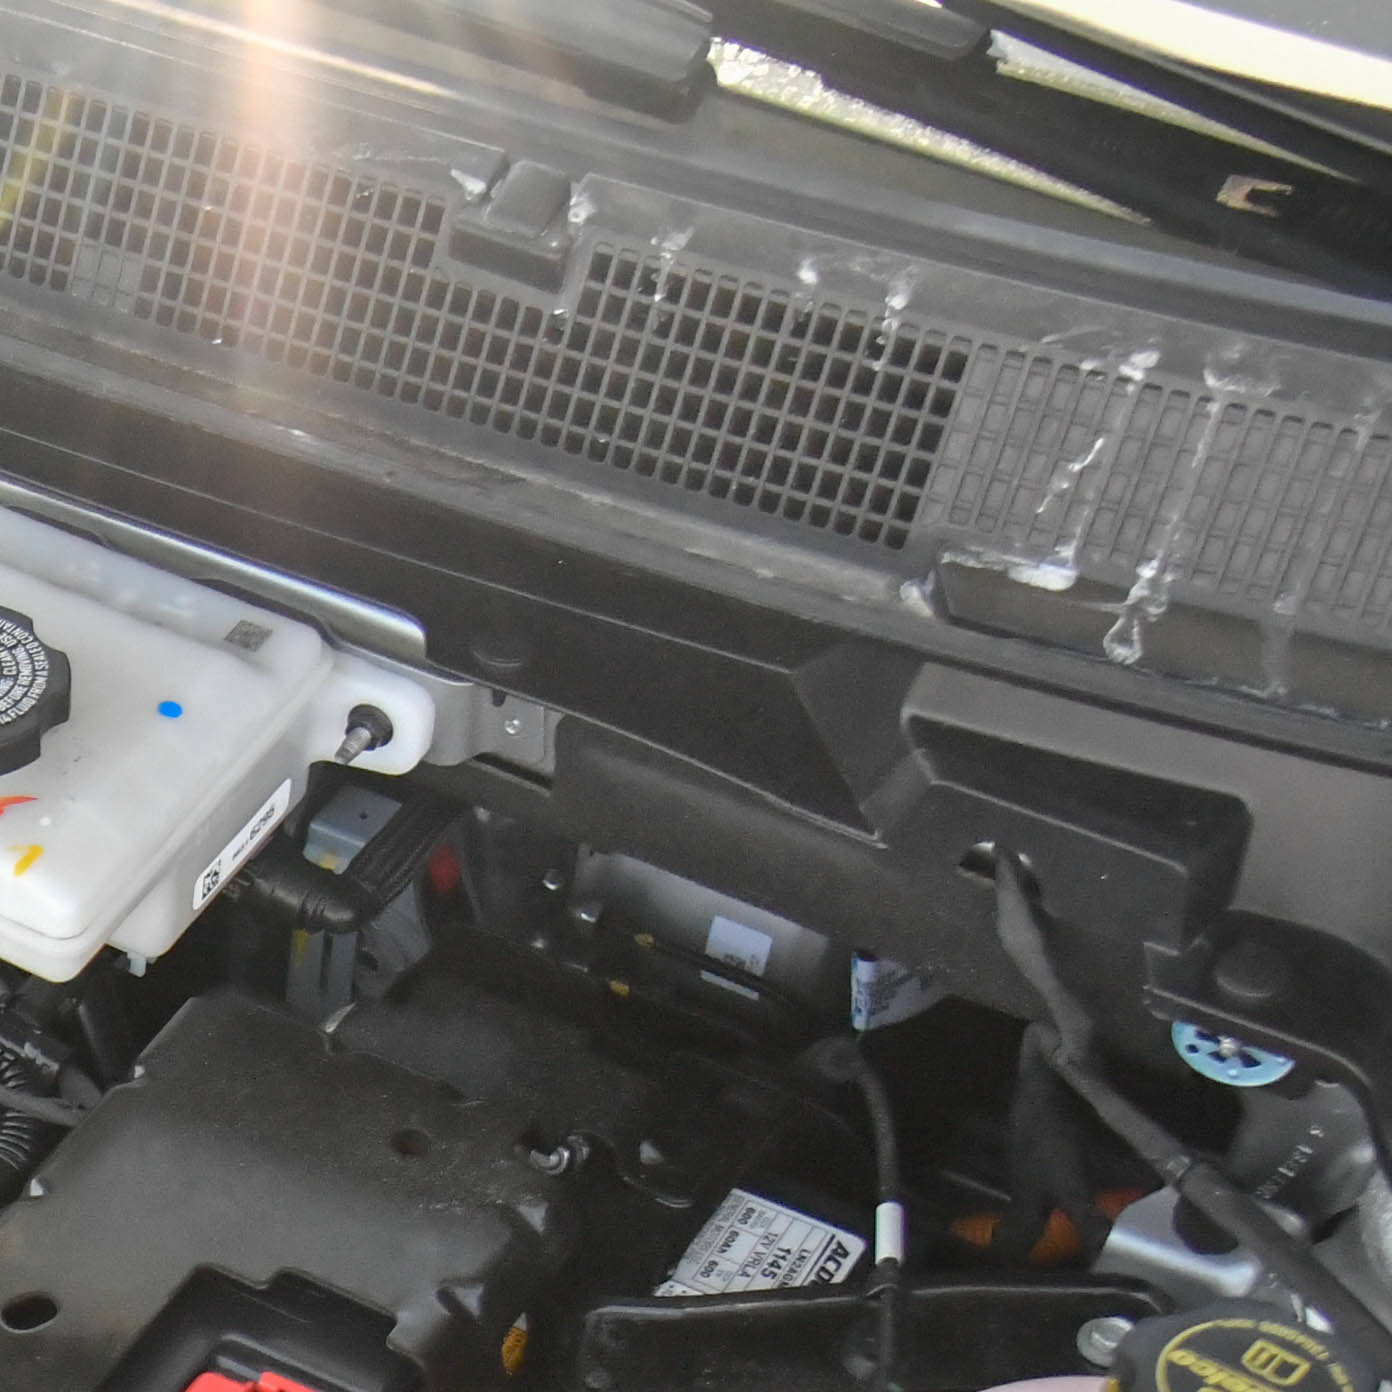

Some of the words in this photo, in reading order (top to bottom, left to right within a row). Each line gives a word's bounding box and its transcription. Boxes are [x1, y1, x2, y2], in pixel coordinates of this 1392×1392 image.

[33, 643, 49, 671] SEALED
[31, 677, 47, 698] FROM
[8, 696, 38, 718] FLUID
[736, 1204, 756, 1227] 600
[759, 1228, 779, 1250] 12V
[698, 1257, 719, 1280] 600
[736, 1246, 766, 1281] VRLA
[759, 1242, 793, 1283] 1145
